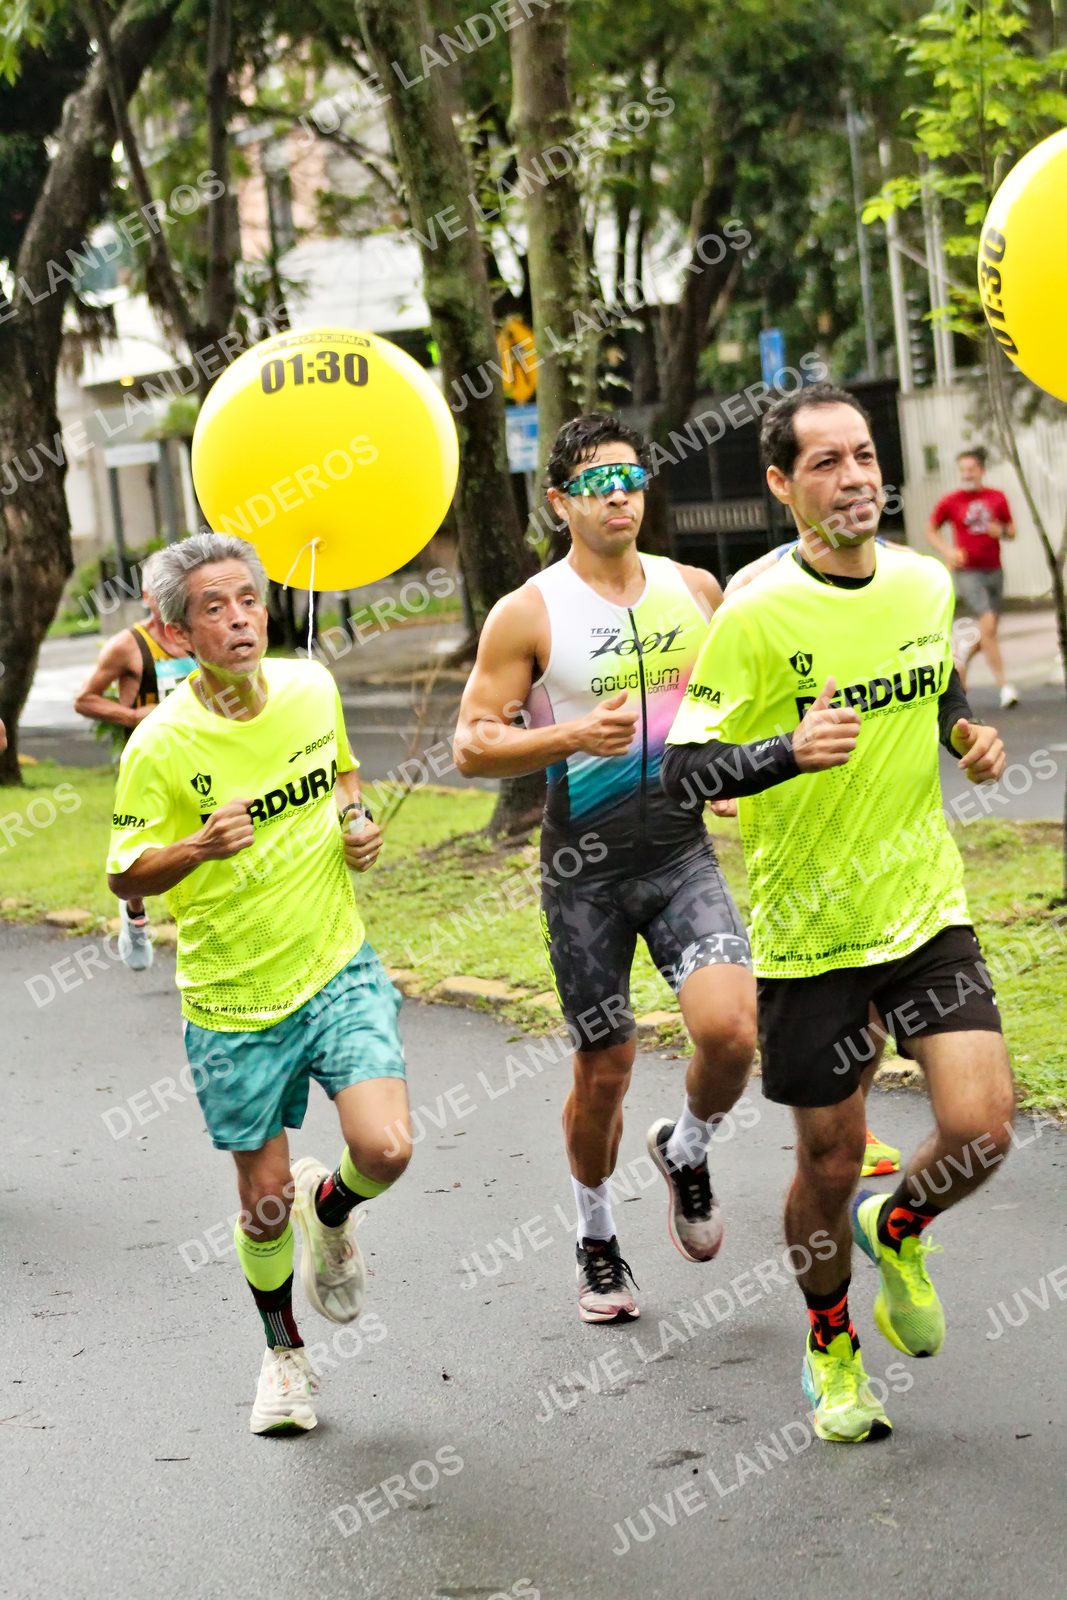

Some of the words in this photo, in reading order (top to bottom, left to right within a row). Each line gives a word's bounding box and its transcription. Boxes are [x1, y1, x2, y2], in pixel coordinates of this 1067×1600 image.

[261, 351, 369, 394] 01:30
[795, 661, 944, 721] PRDUR
[305, 730, 334, 755] BROOKS
[214, 1004, 246, 1015] amigos
[249, 1001, 293, 1014] corriendo
